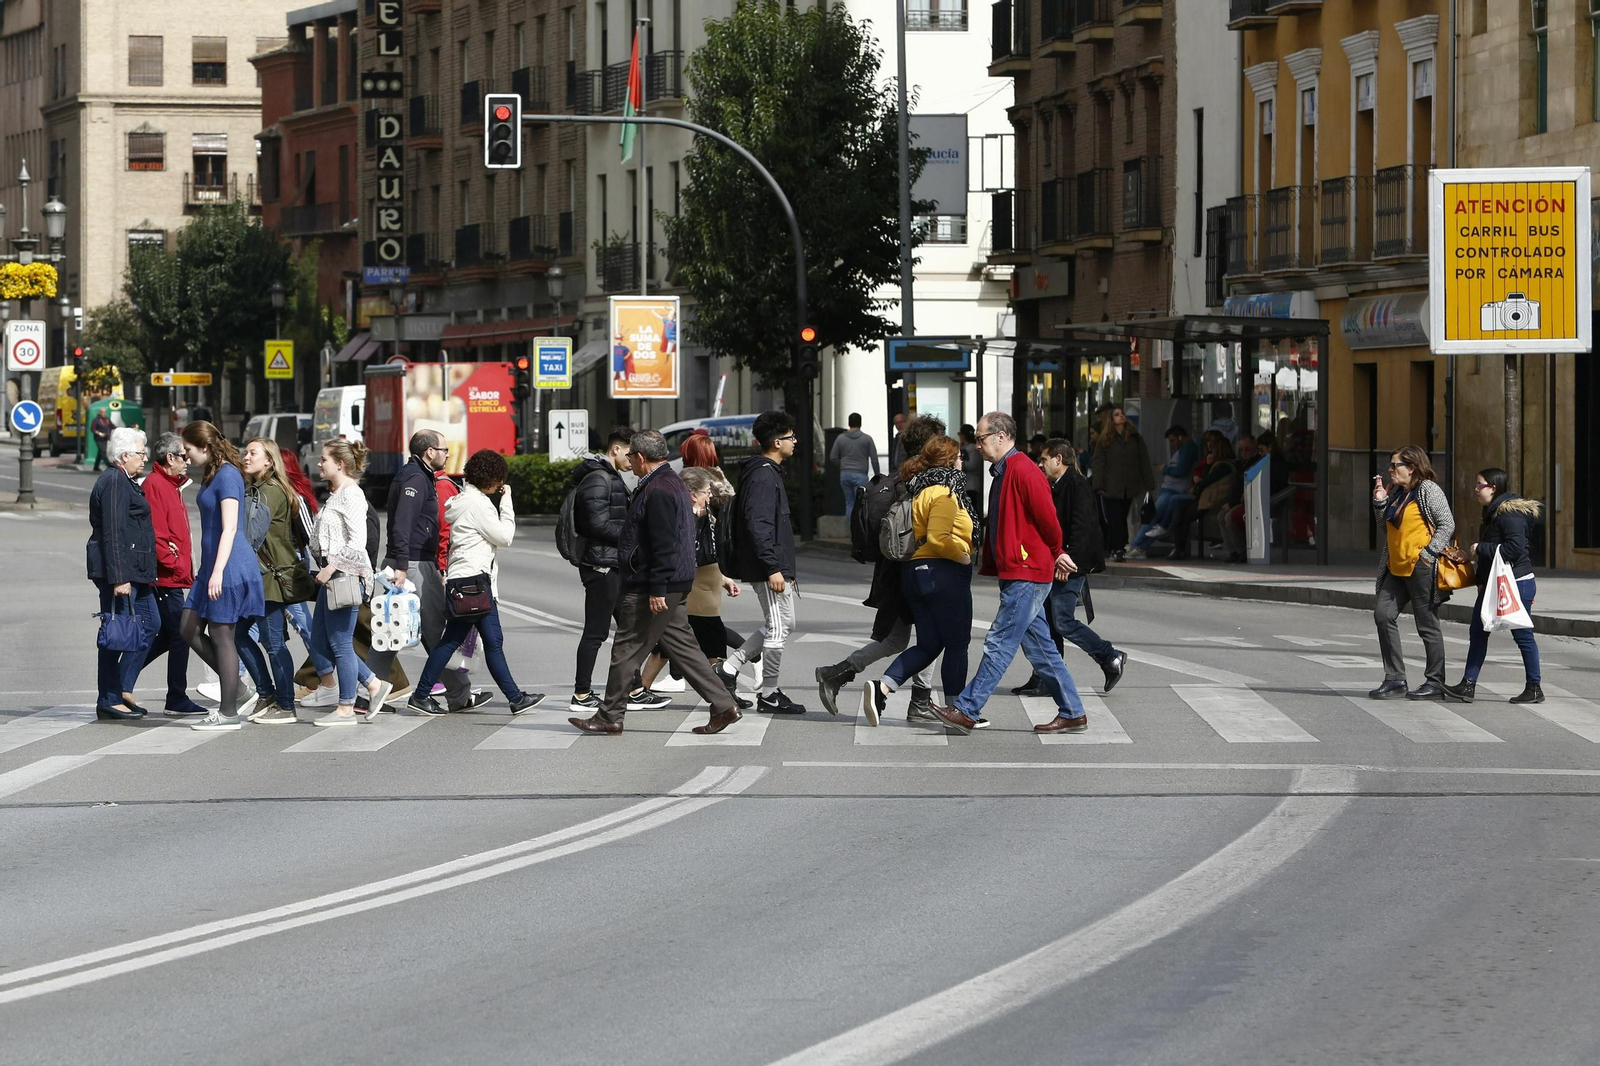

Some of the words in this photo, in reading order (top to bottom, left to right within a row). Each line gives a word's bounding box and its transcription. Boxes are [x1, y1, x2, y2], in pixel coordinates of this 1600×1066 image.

[379, 116, 401, 260] DAURO
[1454, 195, 1566, 214] ATENCIÓN
[1460, 226, 1517, 237] CARRIL
[1528, 225, 1560, 236] BUS
[1455, 246, 1566, 258] CONTROLADO
[1455, 268, 1486, 279] POR
[1497, 265, 1565, 279] CÁMARA
[14, 324, 40, 332] ZONA
[638, 325, 653, 334] LA
[629, 333, 660, 342] SUMA
[637, 342, 653, 351] DE
[19, 348, 35, 356] 30
[633, 350, 657, 360] DOS
[543, 363, 563, 372] TAXI
[469, 391, 500, 400] SABOR
